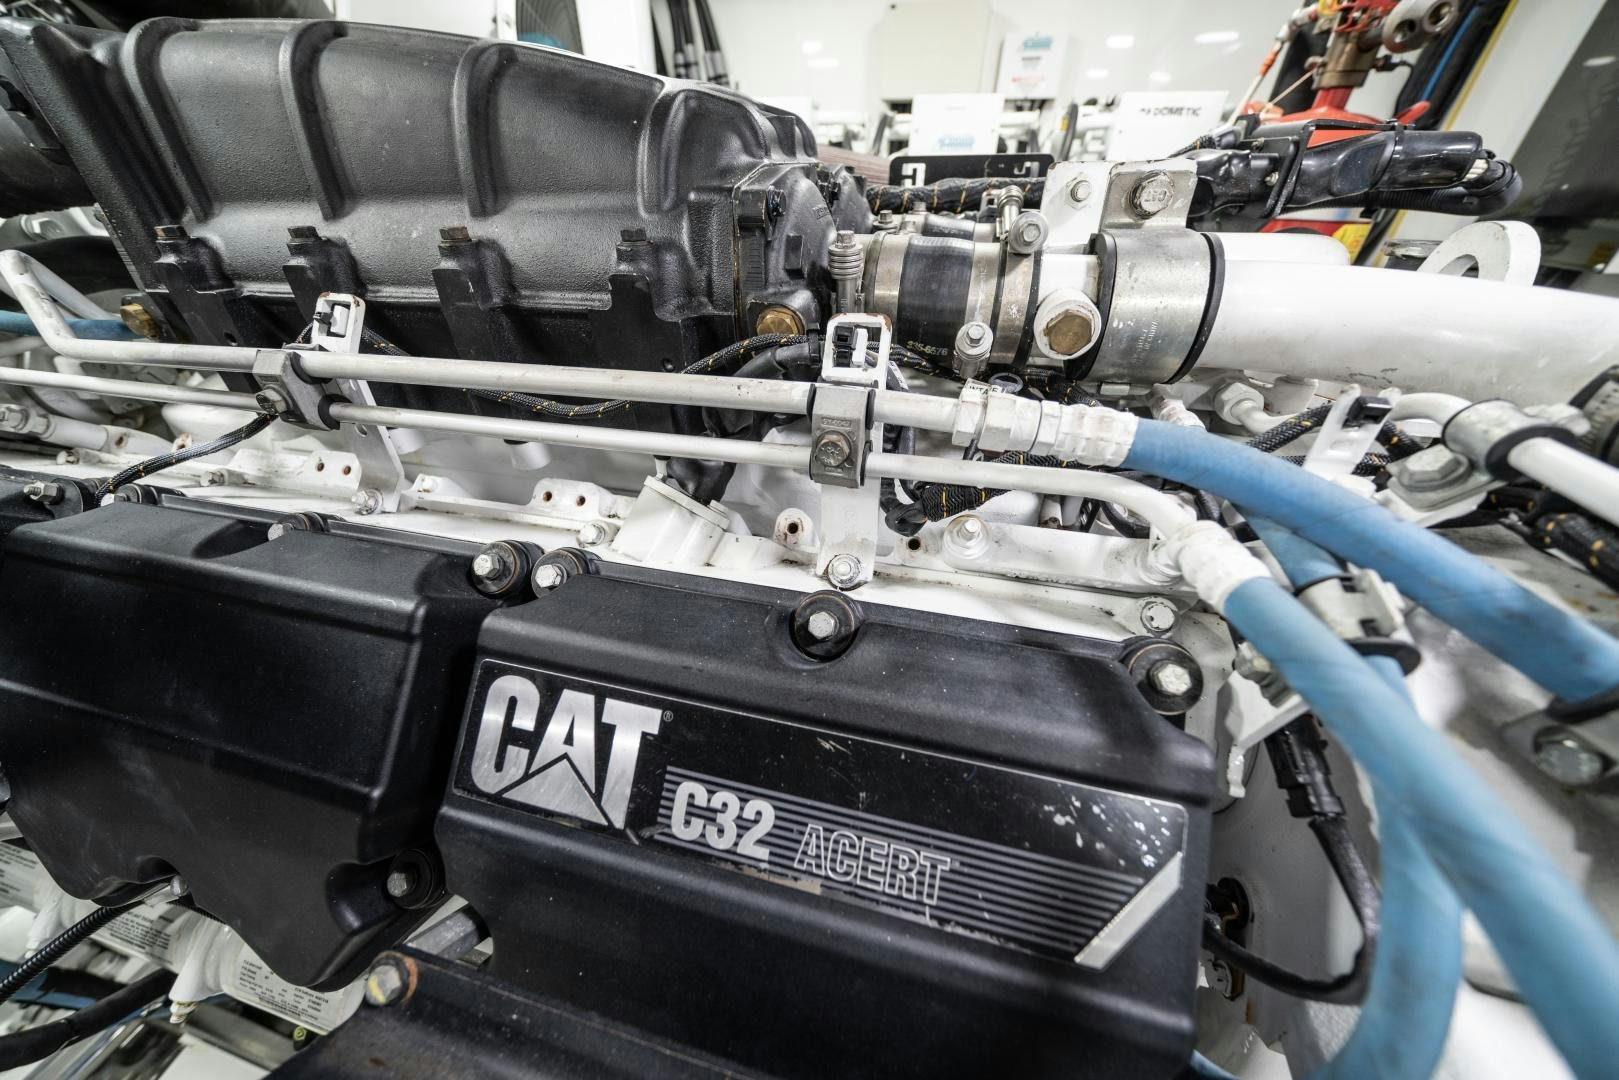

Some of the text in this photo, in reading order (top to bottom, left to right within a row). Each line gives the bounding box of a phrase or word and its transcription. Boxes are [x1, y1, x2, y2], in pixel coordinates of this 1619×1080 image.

[470, 675, 662, 830] CAT
[670, 780, 951, 906] C32 ACERT
